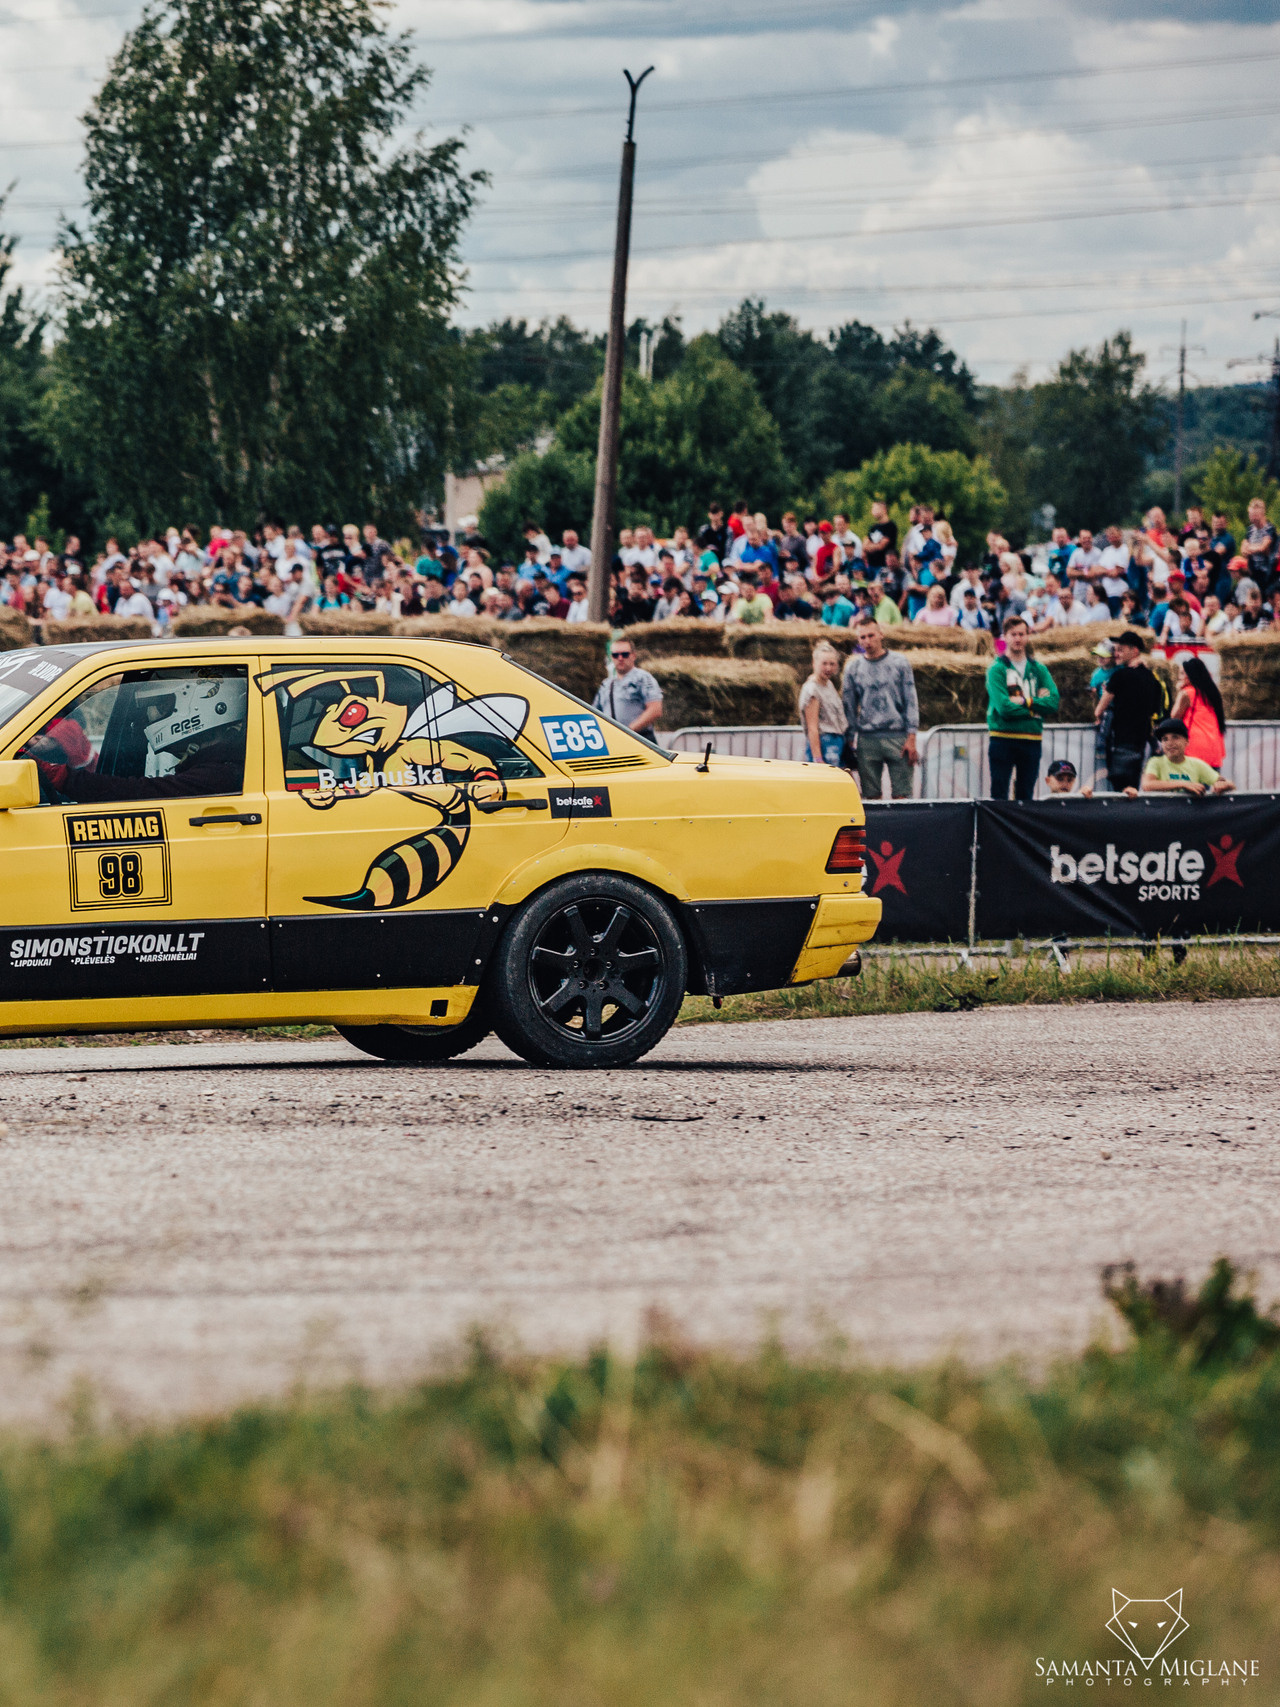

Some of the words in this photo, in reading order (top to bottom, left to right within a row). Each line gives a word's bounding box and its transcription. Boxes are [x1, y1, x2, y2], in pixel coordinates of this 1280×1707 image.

[170, 714, 201, 735] RRS
[542, 719, 604, 753] E85
[318, 764, 445, 790] B.Januška
[556, 796, 594, 806] betsafe
[73, 816, 160, 842] RENMAG
[98, 851, 144, 899] 98
[1050, 841, 1206, 886] betsafe
[1138, 884, 1201, 902] SPORTS
[10, 932, 206, 959] SIMONSTICKON.LT
